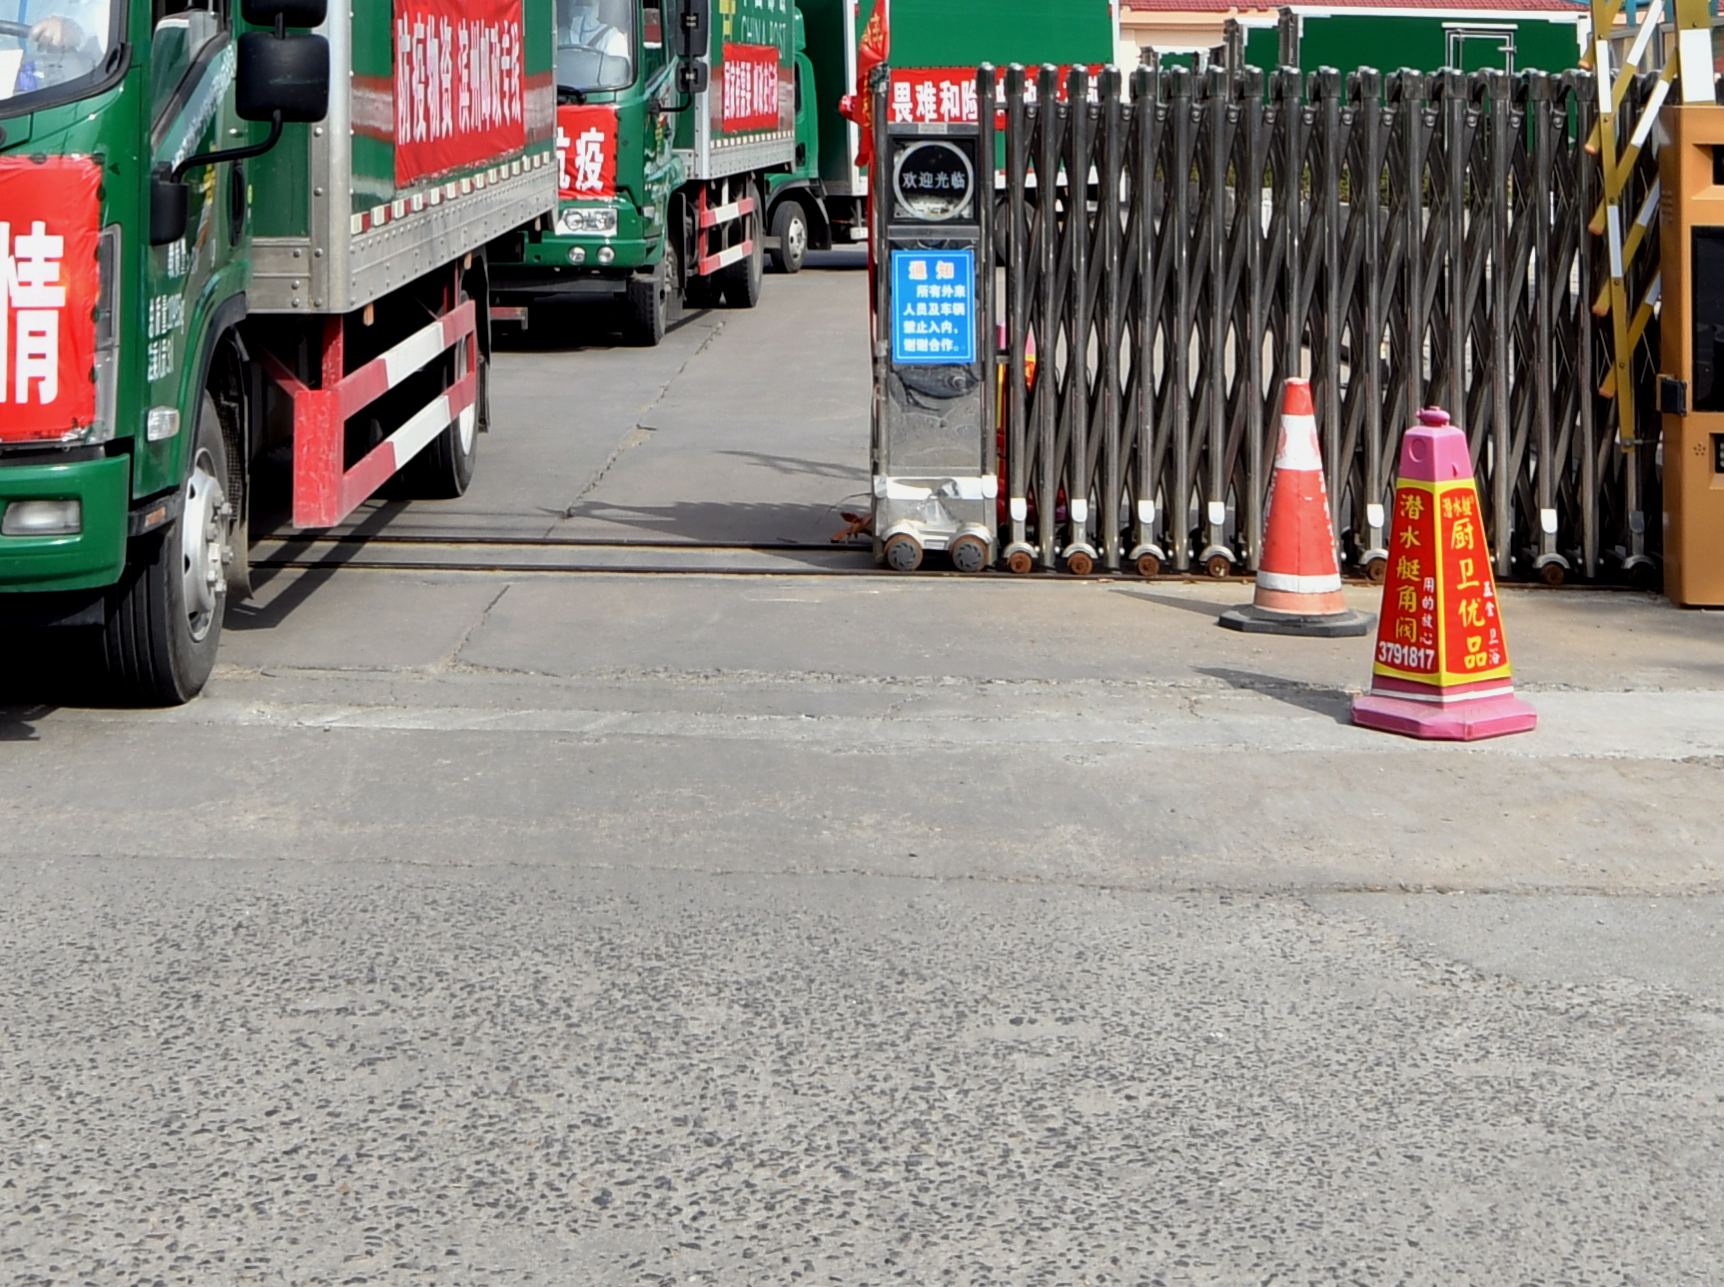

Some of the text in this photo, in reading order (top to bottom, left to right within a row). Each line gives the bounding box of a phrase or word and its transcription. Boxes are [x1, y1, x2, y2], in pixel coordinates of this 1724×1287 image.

[901, 171, 966, 190] 欢迎光临
[908, 260, 955, 280] 通知
[917, 284, 966, 298] 所有外来
[903, 302, 966, 316] 人员及车辆
[1395, 494, 1425, 644] 潜水艇角阀
[1450, 517, 1488, 670] 厨卫优品
[1378, 640, 1435, 670] 3791817
